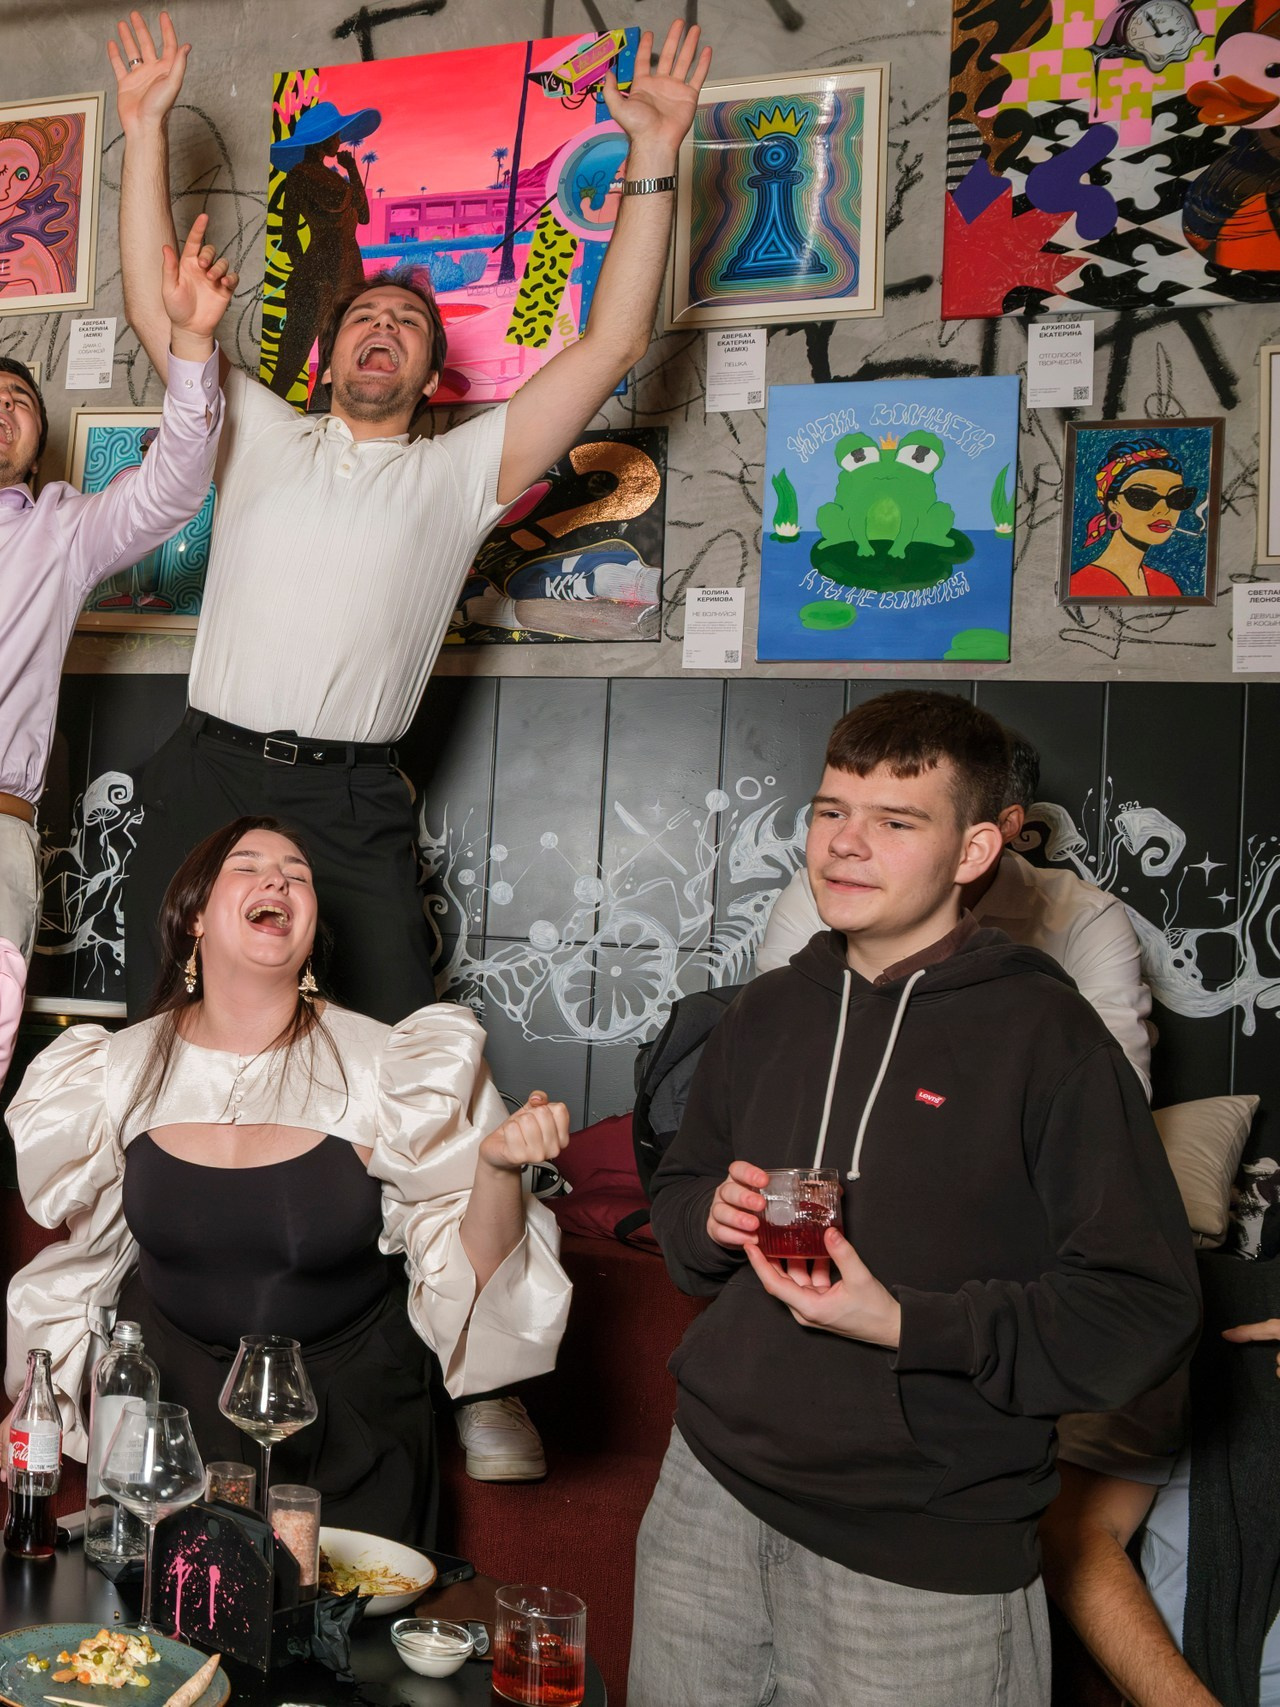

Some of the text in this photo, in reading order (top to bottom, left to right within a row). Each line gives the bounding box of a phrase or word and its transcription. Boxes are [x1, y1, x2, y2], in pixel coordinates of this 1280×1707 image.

[556, 313, 574, 337] NO
[1041, 323, 1081, 331] АРХИПОВА
[721, 332, 752, 340] АВЕРБАХ
[1039, 330, 1083, 338] ЕКАТЕРИНА
[717, 339, 756, 347] ЕКАТЕРИНА
[1039, 351, 1082, 359] ОТГОЛОСКИ
[1039, 358, 1083, 367] ТВОРЧЕСТВА
[844, 586, 878, 608] НЕ
